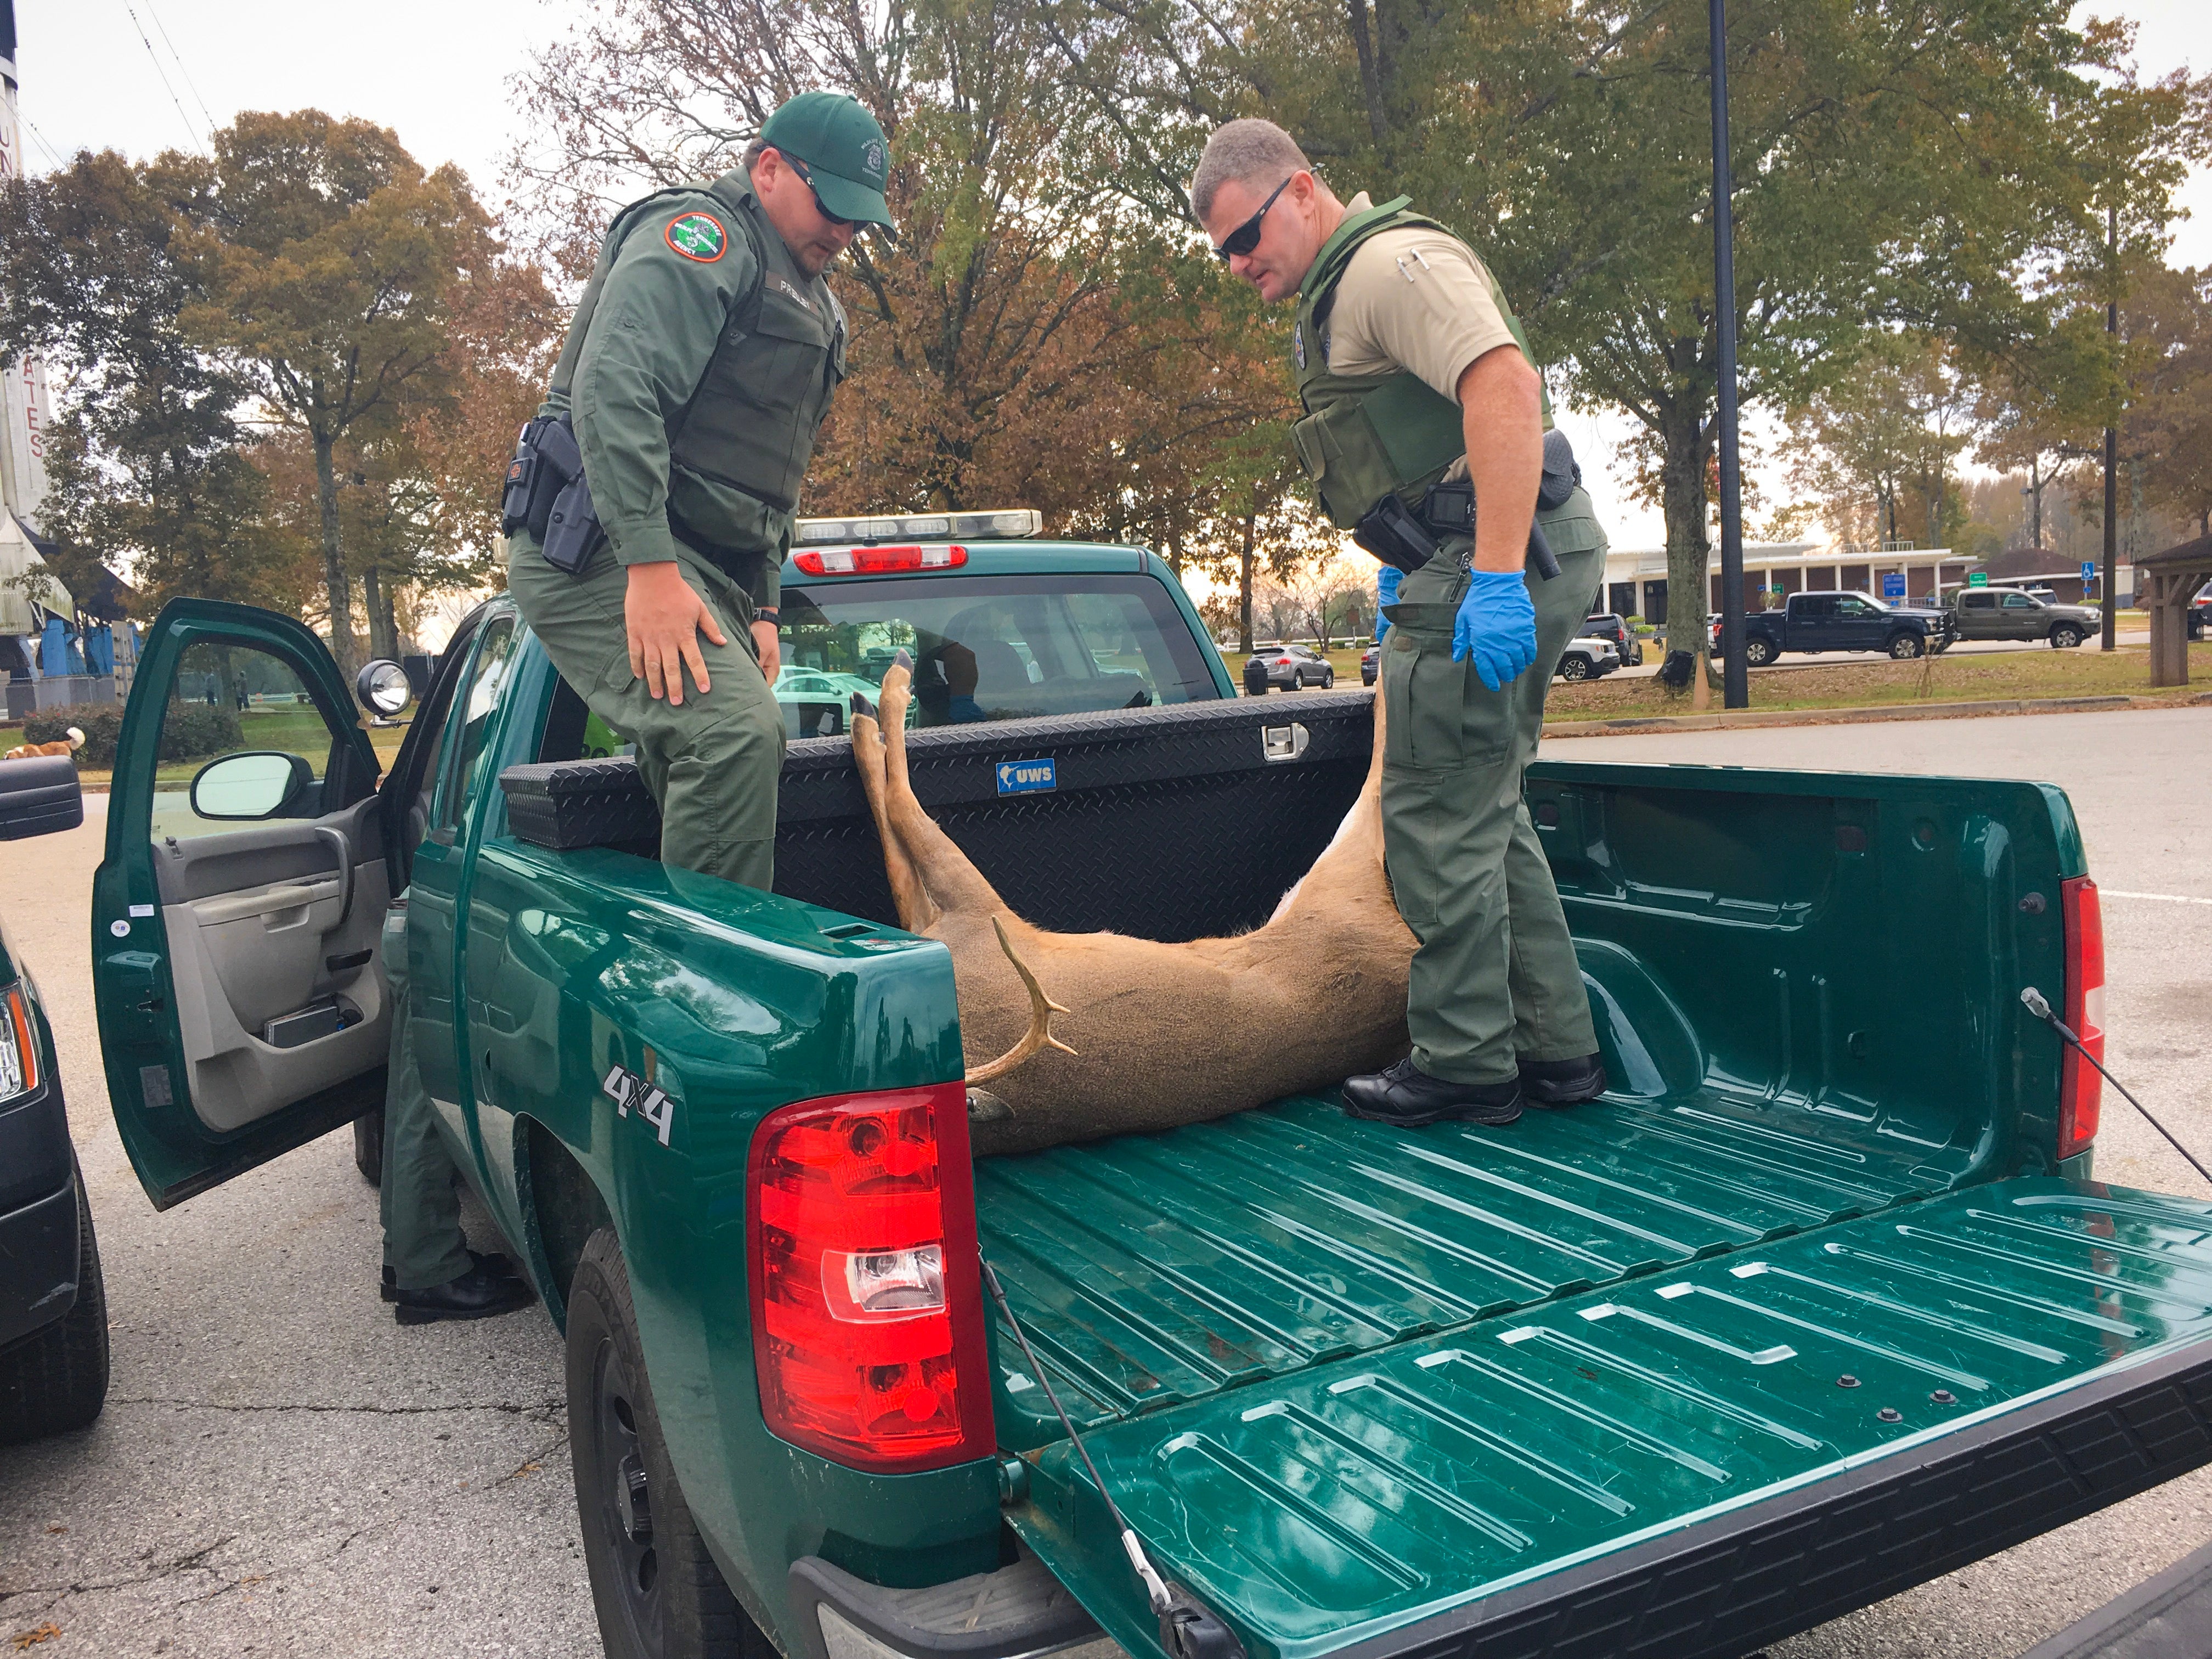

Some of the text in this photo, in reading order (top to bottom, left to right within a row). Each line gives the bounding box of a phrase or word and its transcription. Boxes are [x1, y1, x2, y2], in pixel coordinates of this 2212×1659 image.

[692, 215, 722, 236] TENNESSEE
[673, 240, 696, 255] AGENCY
[1016, 766, 1052, 783] UWS
